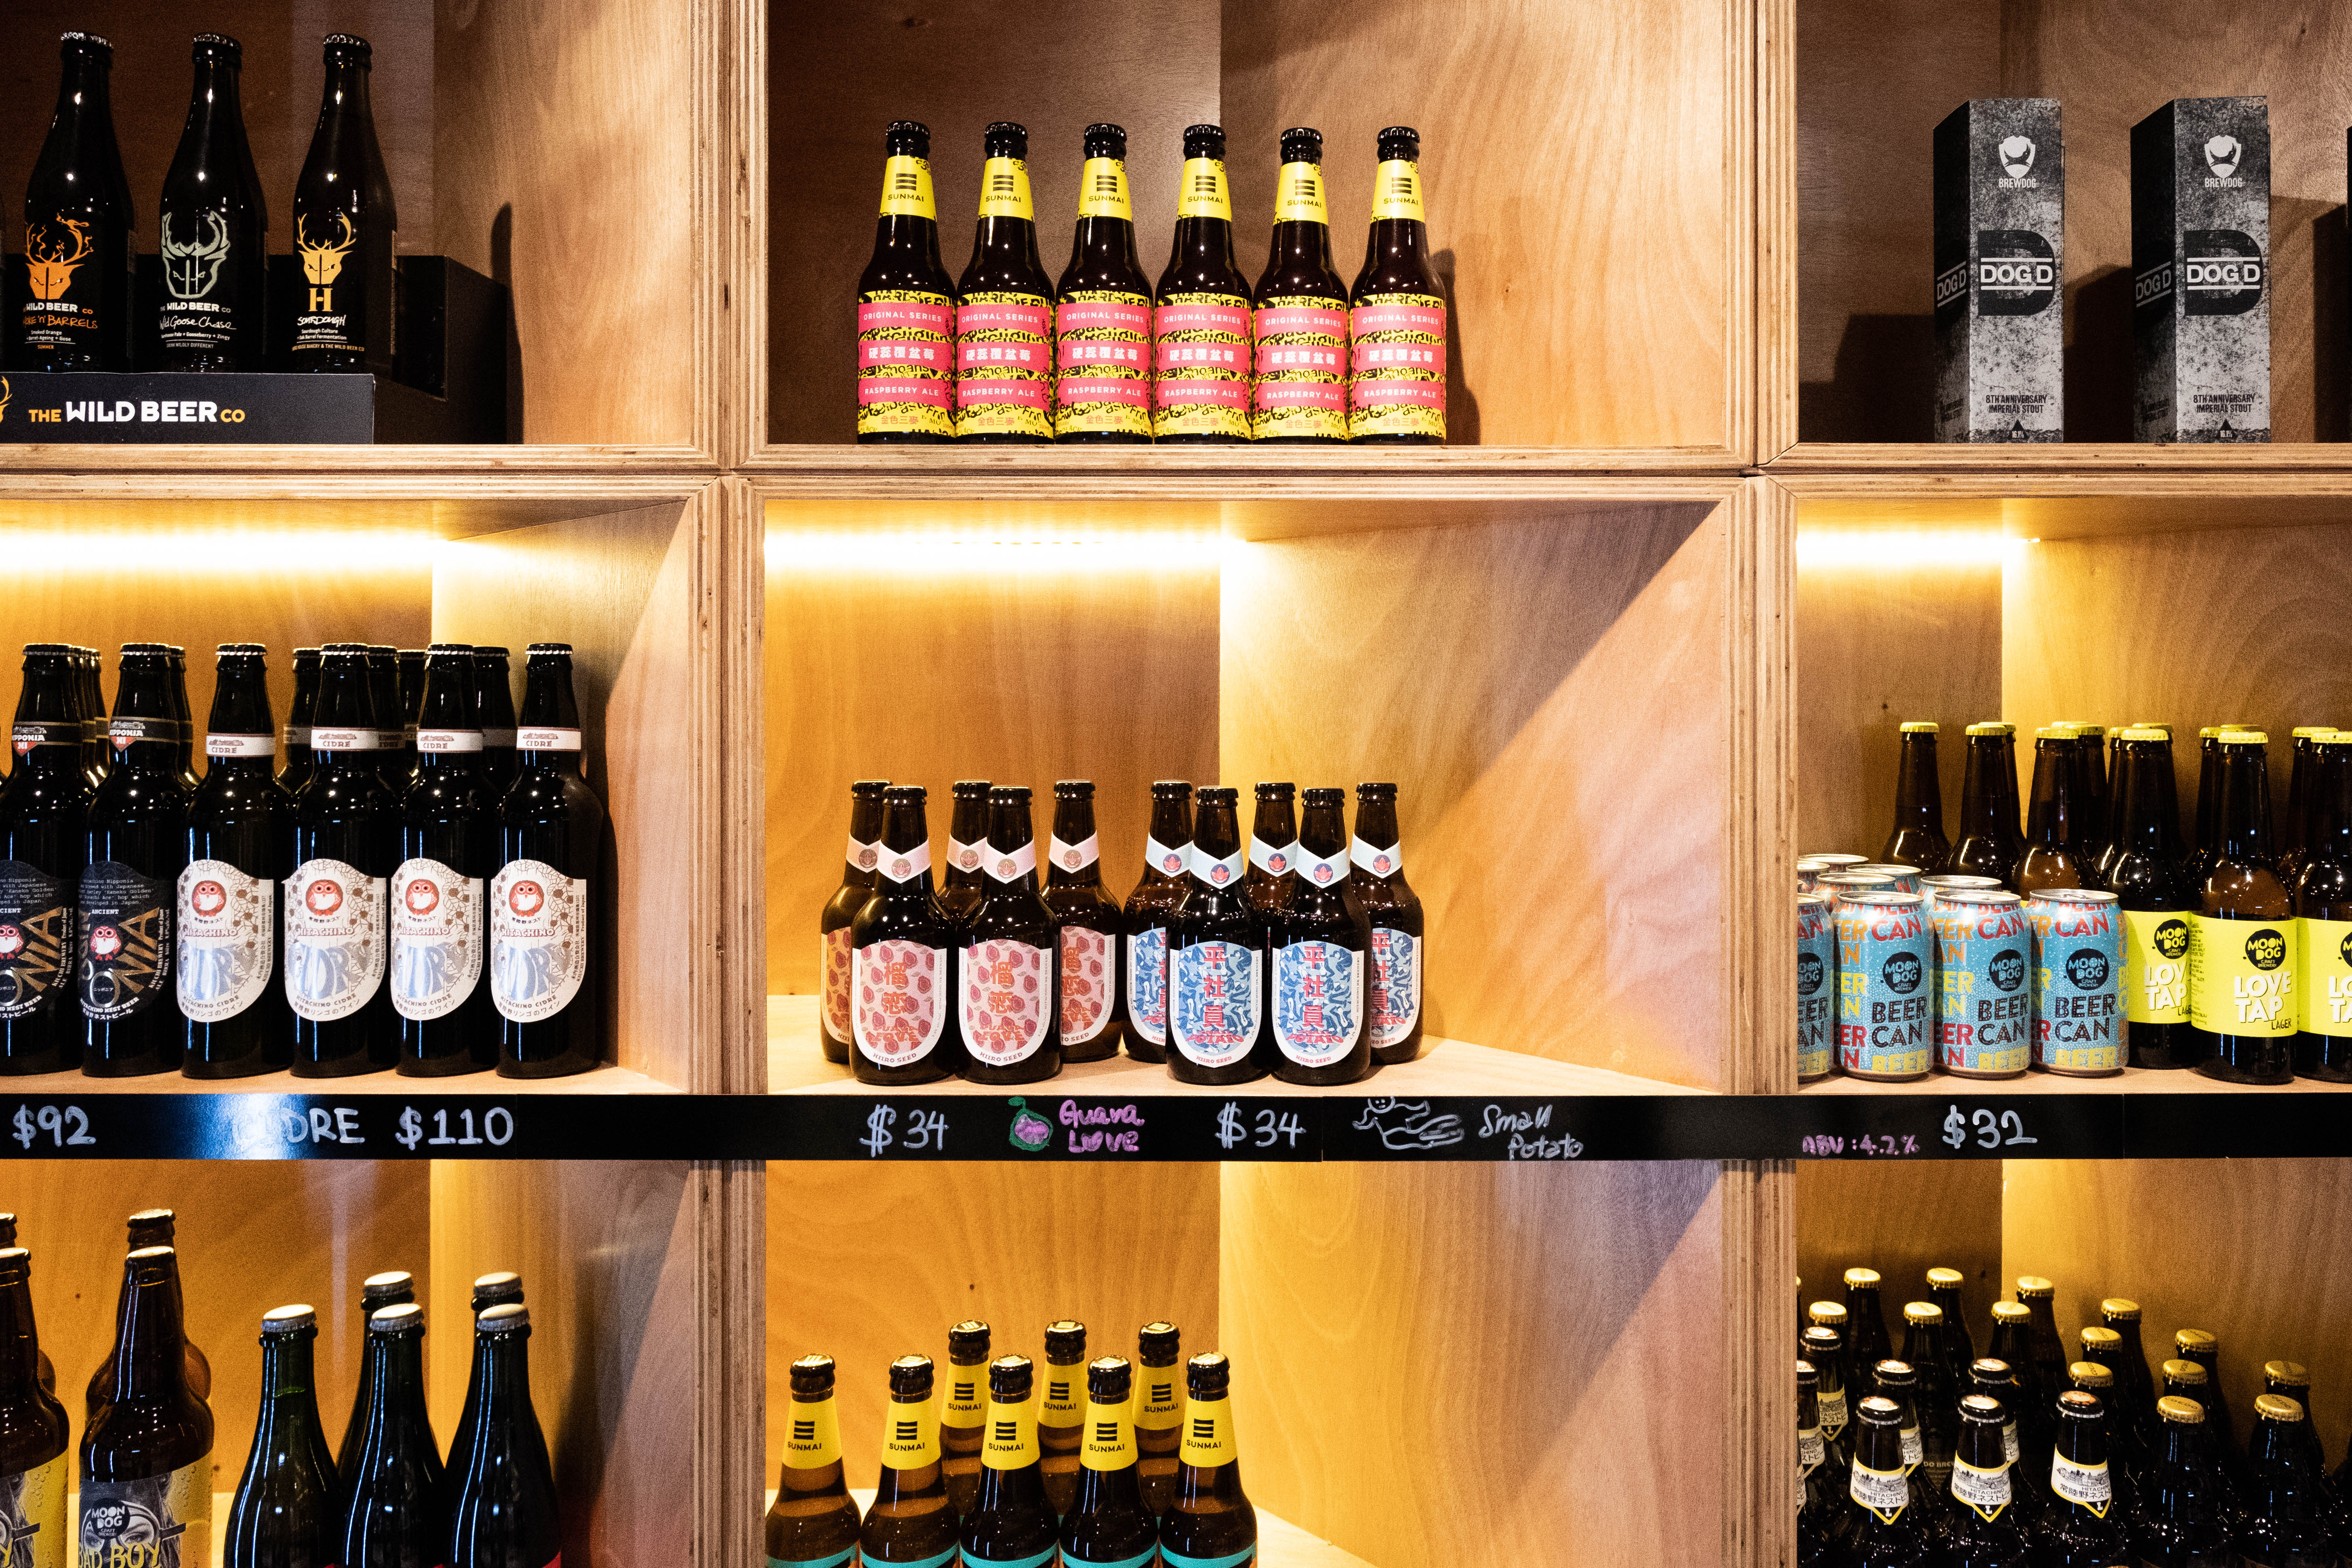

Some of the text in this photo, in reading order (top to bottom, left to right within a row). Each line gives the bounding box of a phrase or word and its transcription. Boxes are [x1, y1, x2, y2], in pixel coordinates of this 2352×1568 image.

[1999, 178, 2036, 188] BREWDOG
[2205, 177, 2243, 187] BREWDOG
[888, 194, 924, 202] SUNMAI
[986, 194, 1021, 203] SUNMAI
[1089, 195, 1124, 204] SUNMAI
[1188, 196, 1223, 204] SUNMAI
[1287, 200, 1321, 208] SUNMAI
[1384, 197, 1418, 205] SUNMAI
[1981, 265, 2032, 282] DOG
[2187, 265, 2238, 282] DOG
[1937, 274, 1958, 300] DOG
[2136, 275, 2161, 300] DOG
[26, 303, 44, 311] WILD
[46, 303, 78, 312] BEER
[167, 302, 187, 310] WILD
[189, 302, 219, 312] BEER
[47, 315, 98, 329] BARRELS
[170, 316, 198, 329] Goose
[198, 317, 237, 329] Chase
[864, 311, 942, 322] ORIGINAL SERIES
[962, 314, 1038, 323] ORIGINAL SERIES
[1067, 312, 1143, 322] ORIGINAL SERIES
[1164, 314, 1240, 324] ORIGINAL SERIES
[1363, 315, 1438, 324] ORIGINAL SERIES
[963, 388, 1014, 397] RASPBERRY
[1126, 388, 1141, 396] ALE
[1165, 389, 1218, 397] RASPBERRY
[1364, 389, 1418, 397] RASPBERRY
[1986, 395, 2047, 403] 8TH ANNIVERSARY
[2194, 394, 2255, 403] 8TH ANNIVERSARY
[28, 401, 245, 423] THE WILD BEER CO
[1989, 405, 2044, 413] IMPERIAL STOUT
[2197, 404, 2252, 413] IMPERIAL STOUT
[881, 416, 918, 424] 金色三麥
[978, 417, 1014, 425] 金色三麥
[1872, 916, 1921, 941] CAN
[1978, 913, 2024, 940] CAN
[2055, 913, 2109, 937] CAN
[502, 929, 555, 937] HITACHINO
[2248, 937, 2282, 950] MOON
[2256, 947, 2280, 960] DOG
[1885, 960, 1919, 974] MOON
[2068, 956, 2106, 970] MOON
[1893, 971, 1917, 983] DOG
[2076, 967, 2103, 979] DOG
[2145, 962, 2191, 987] LOV
[1203, 947, 1226, 1028] 平社員
[1302, 946, 1325, 1028] 平社員
[2234, 971, 2292, 998] LOVE
[398, 993, 452, 1006] HITACHINO CIDRE
[501, 995, 557, 1008] HITACHINO CIDRE
[2145, 983, 2188, 1010] TAP
[1872, 997, 1927, 1023] BEER
[1978, 993, 2028, 1021] BEER
[2055, 994, 2115, 1018] BEER
[2234, 996, 2283, 1023] TAP
[2055, 1018, 2109, 1042] CAN
[2272, 1018, 2291, 1030] LAGER
[1872, 1022, 1922, 1048] CAN
[1978, 1018, 2025, 1045] CAN
[1186, 1034, 1244, 1044] POTATO
[873, 1053, 916, 1063] HIIRO SEED
[980, 1052, 1022, 1062] HIIRO SEED
[1059, 1100, 1144, 1128] Guava
[13, 1104, 96, 1149] $92
[1478, 1104, 1553, 1138] Small
[1942, 1105, 2037, 1149] $32
[396, 1106, 513, 1150] $110
[1803, 1134, 1844, 1156] ABV
[948, 1402, 982, 1412] SUNMAI
[1043, 1402, 1077, 1411] SUNMAI
[787, 1441, 822, 1451] SUNMAI
[889, 1442, 925, 1452] SUNMAI
[989, 1442, 1023, 1452] SUNMAI
[1089, 1443, 1125, 1453] SUNMAI
[1187, 1439, 1221, 1450] SUNMAI
[92, 1506, 125, 1518] MOON
[1986, 1506, 1992, 1514] L
[97, 1516, 122, 1528] DOG
[110, 1537, 161, 1568] BOY
